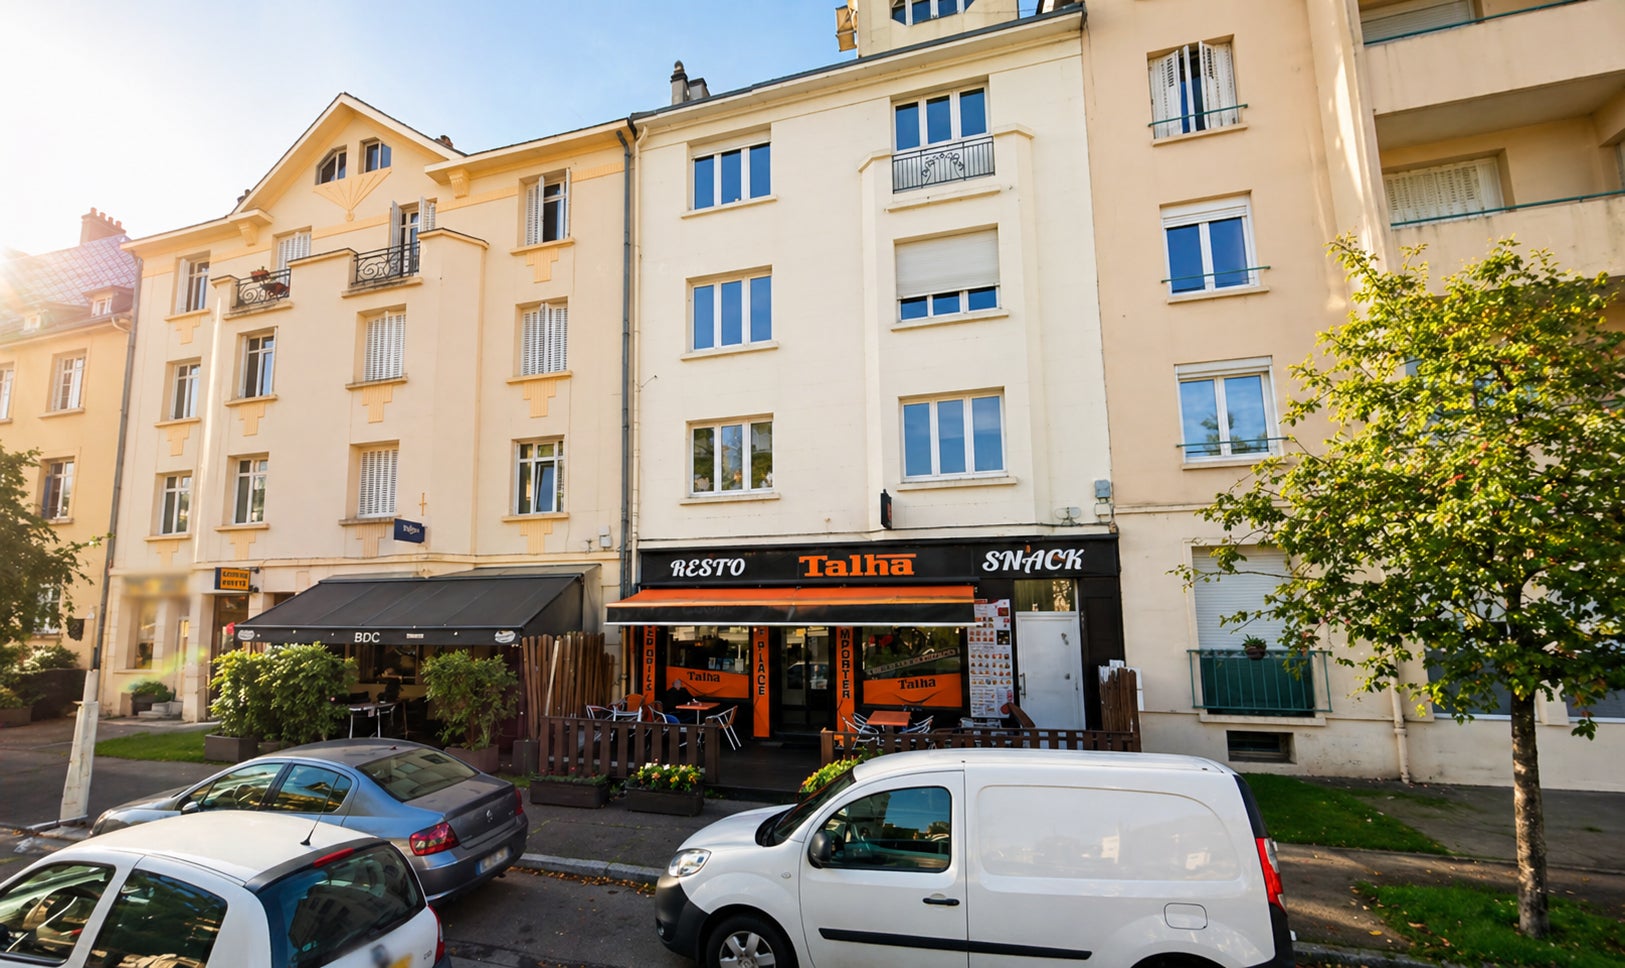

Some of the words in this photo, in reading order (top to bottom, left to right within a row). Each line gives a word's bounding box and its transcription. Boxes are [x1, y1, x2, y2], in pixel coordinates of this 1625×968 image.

[982, 548, 1085, 574] SNACK
[354, 632, 380, 643] BDC
[687, 671, 721, 682] Talha
[897, 678, 937, 690] Talha
